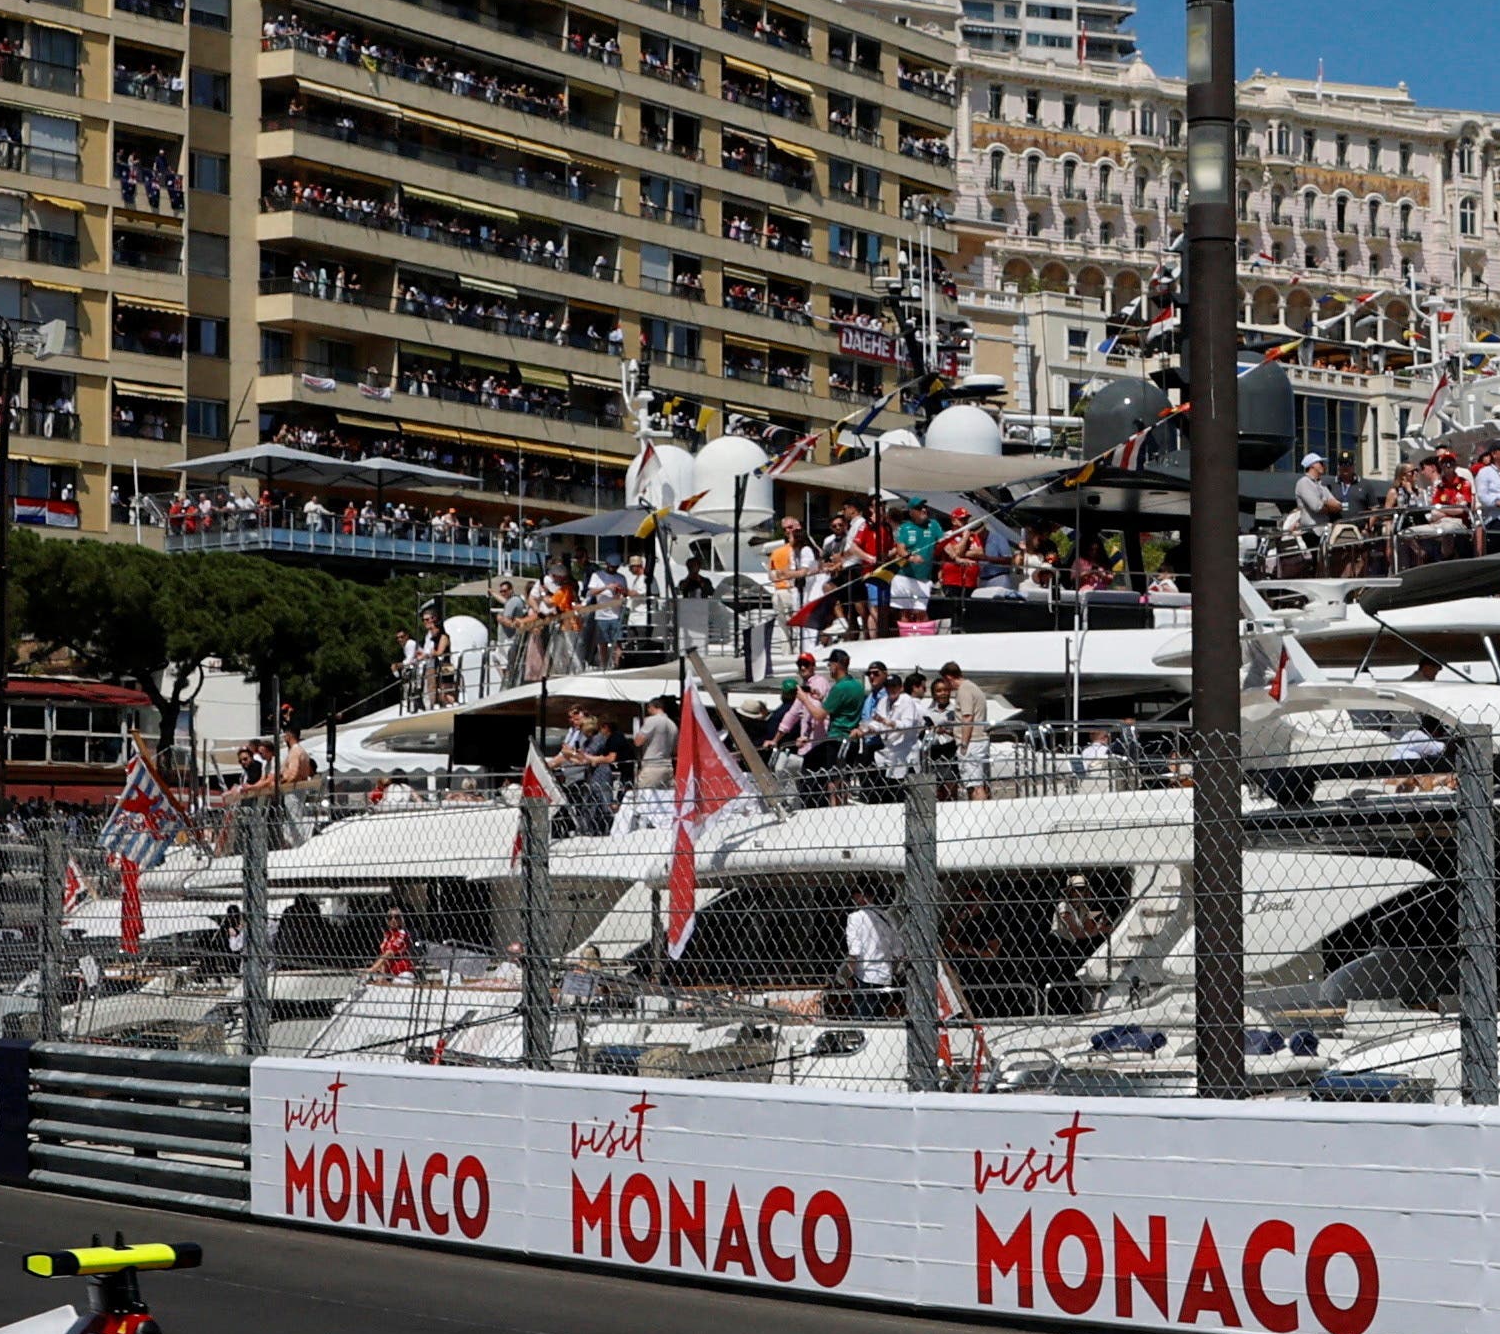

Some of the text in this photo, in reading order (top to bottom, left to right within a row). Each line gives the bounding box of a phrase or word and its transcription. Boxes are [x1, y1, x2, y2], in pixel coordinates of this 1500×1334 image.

[841, 327, 894, 357] DAGHE
[283, 1071, 347, 1136] visit
[572, 1090, 657, 1163] visit
[285, 1142, 491, 1239] MONACO
[974, 1111, 1096, 1196] visit
[573, 1169, 852, 1288] MONACO
